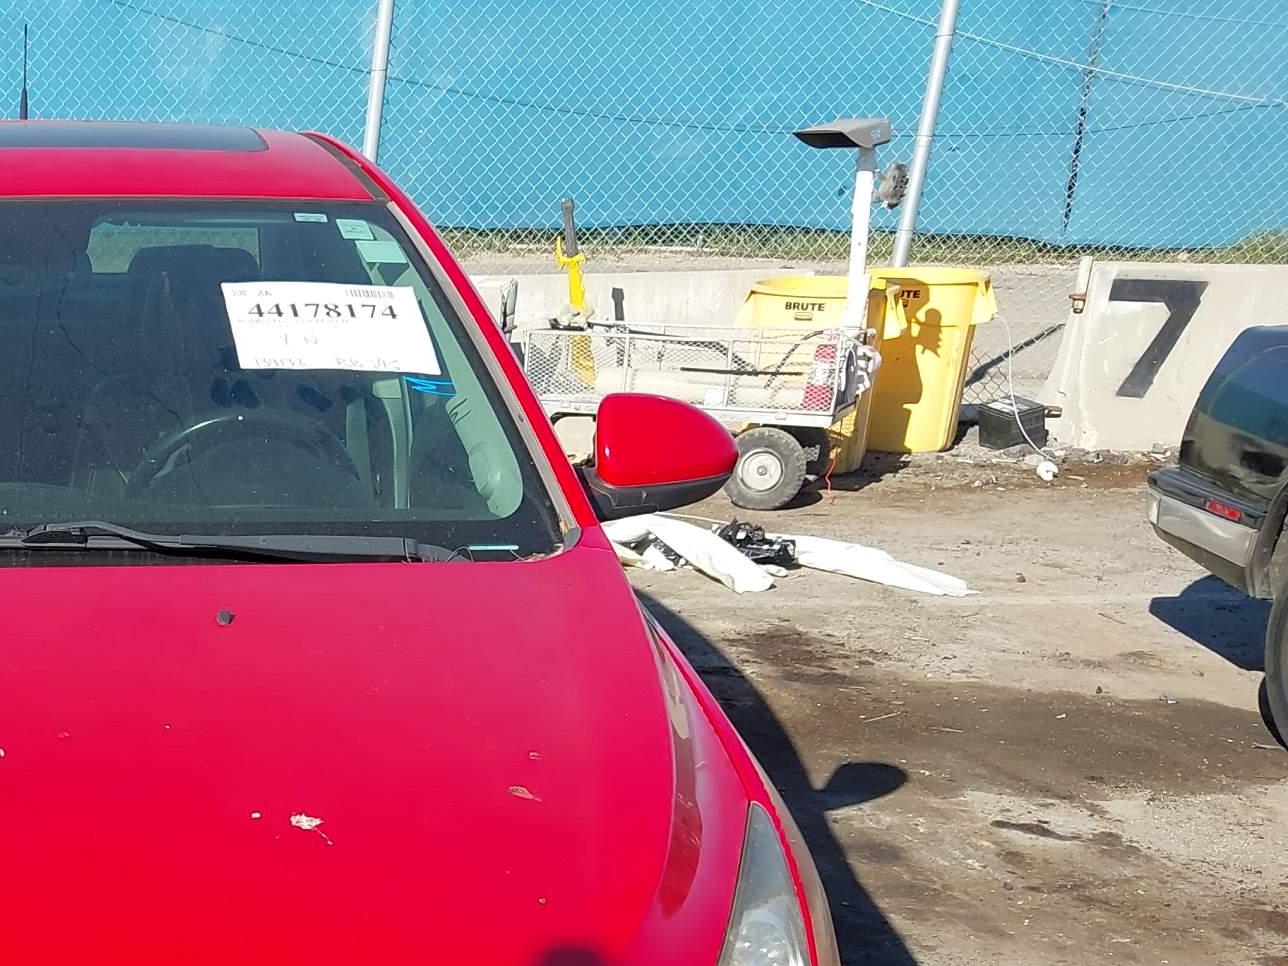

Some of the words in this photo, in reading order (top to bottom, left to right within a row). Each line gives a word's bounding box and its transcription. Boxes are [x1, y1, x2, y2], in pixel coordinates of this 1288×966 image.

[247, 303, 398, 320] 44178174
[784, 301, 826, 312] BRUTE
[1109, 279, 1209, 398] 7
